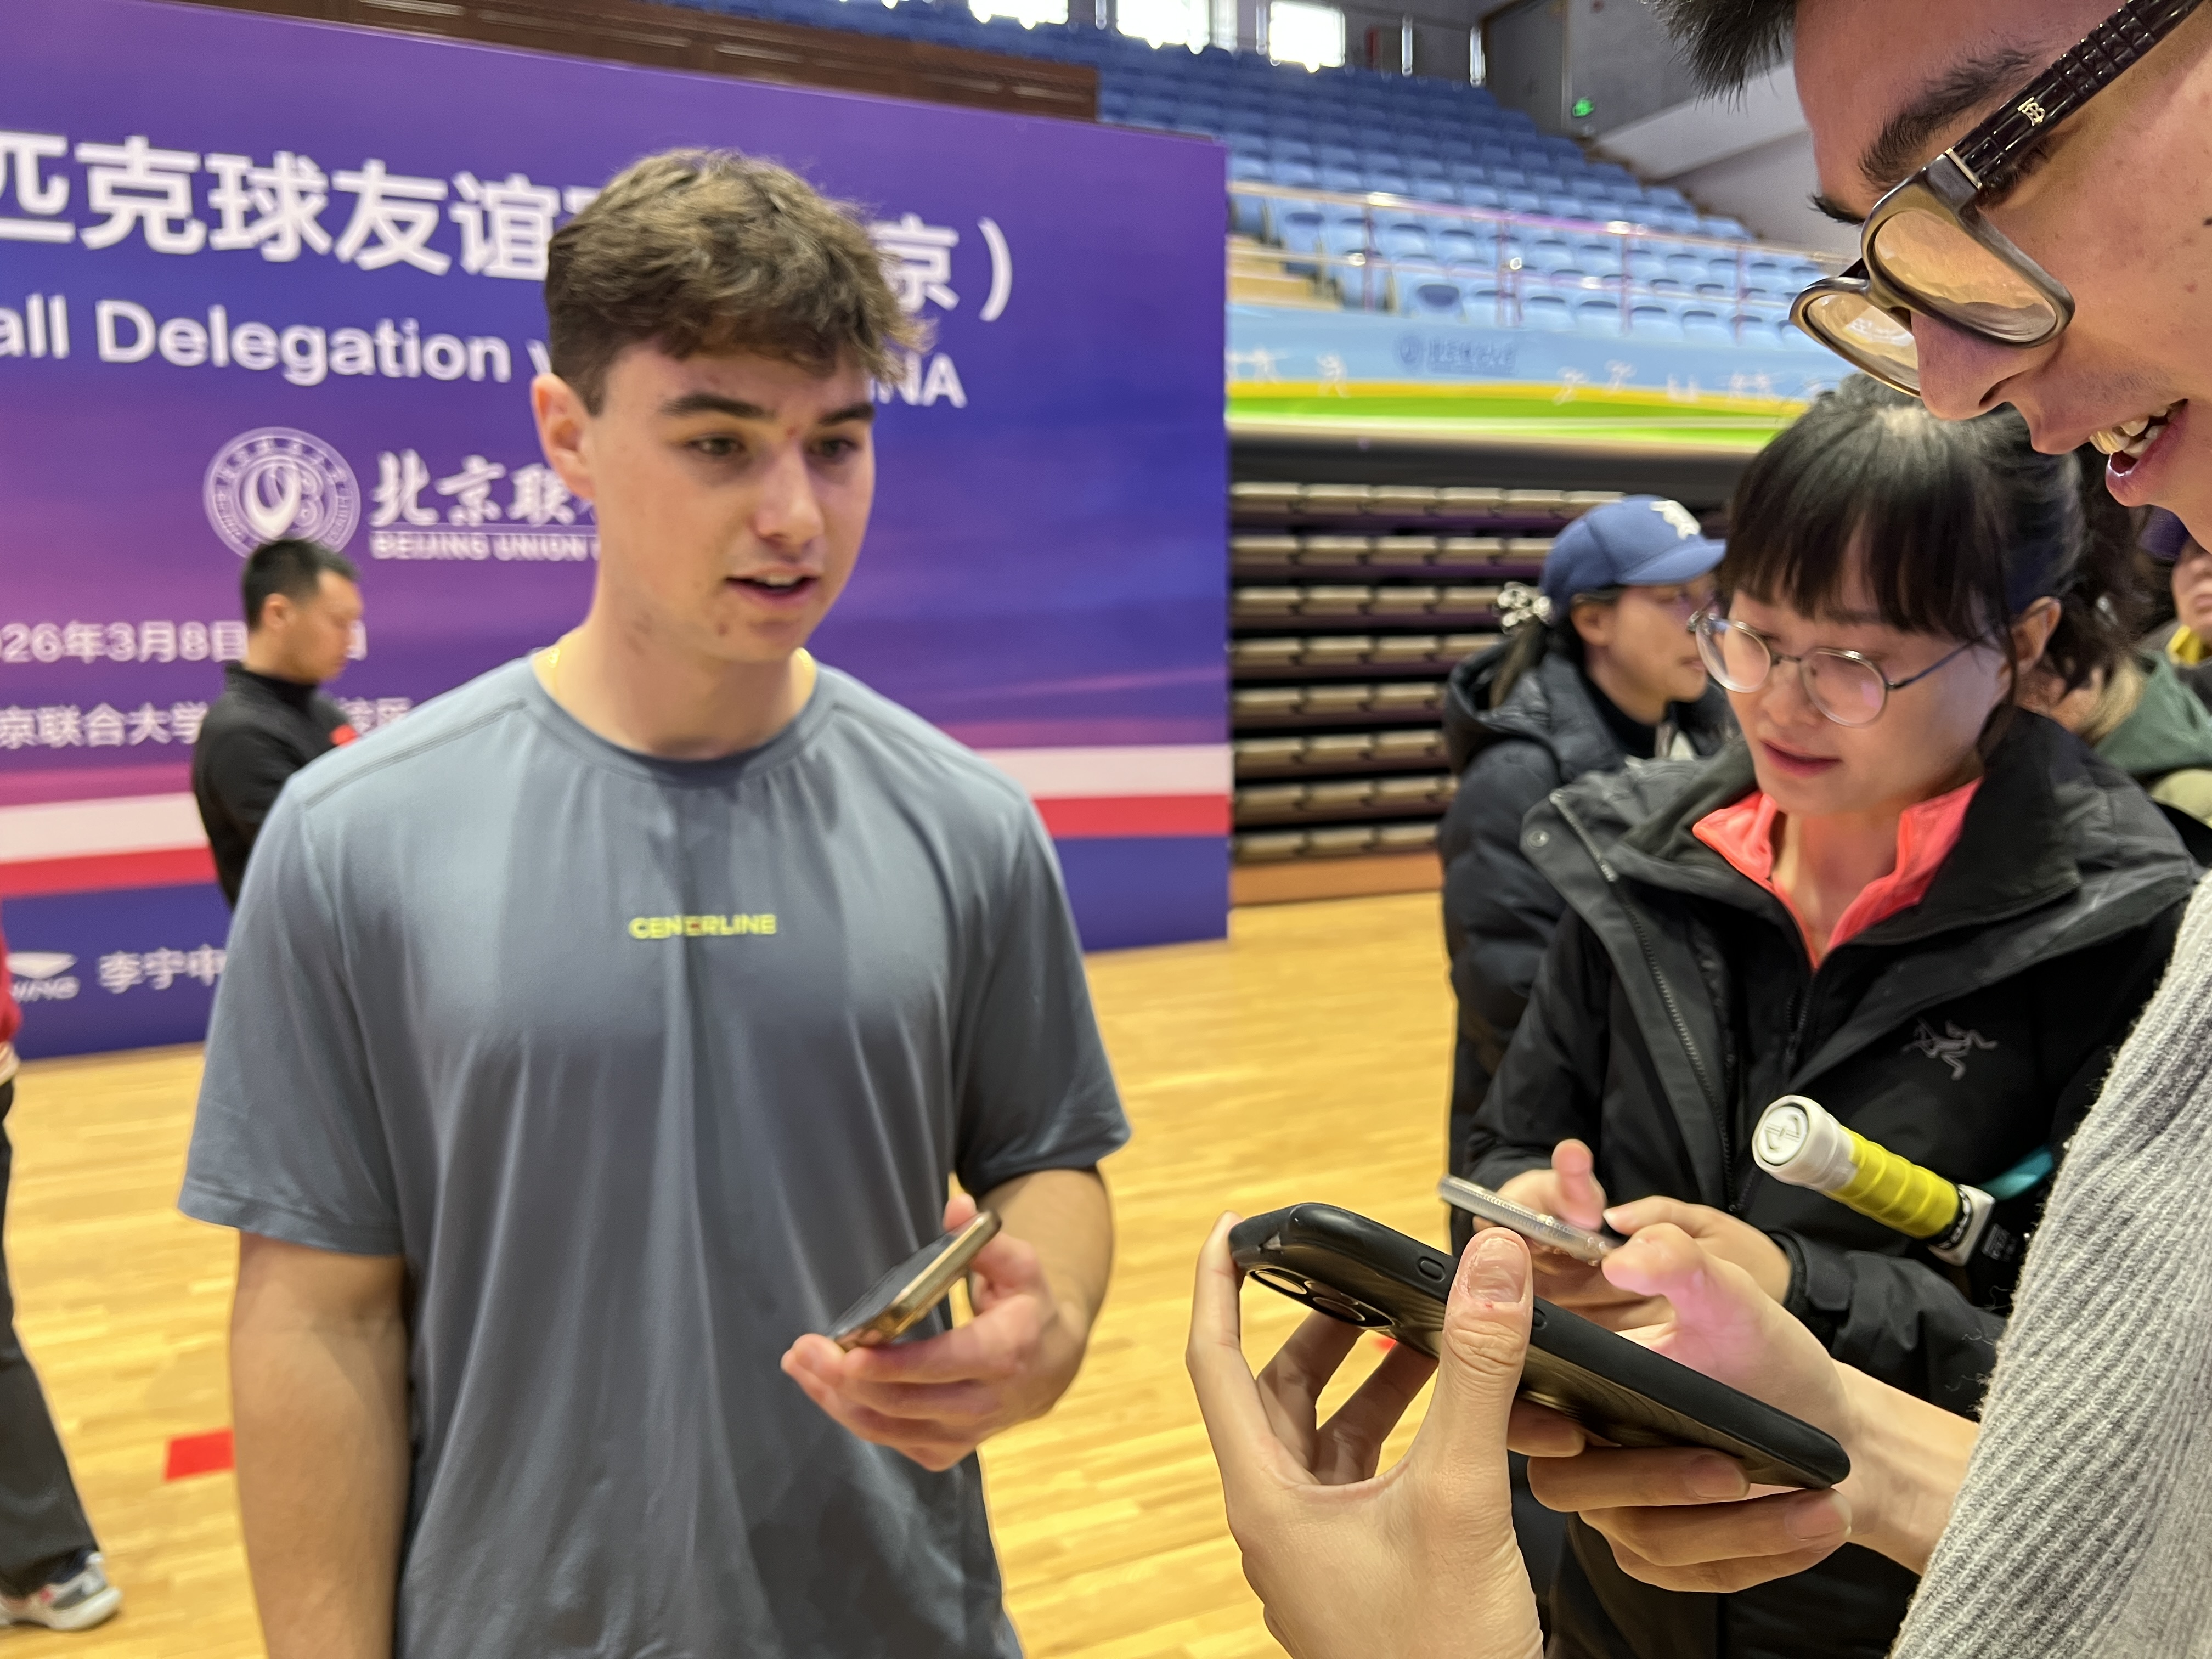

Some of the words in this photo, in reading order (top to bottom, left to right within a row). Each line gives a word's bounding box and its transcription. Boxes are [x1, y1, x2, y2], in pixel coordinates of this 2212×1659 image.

[0, 129, 602, 282] 匹克球友谊
[95, 300, 511, 386] Delegation
[870, 352, 968, 409] NA
[370, 448, 596, 527] 北京联
[369, 533, 492, 560] BEIJING
[493, 535, 588, 561] UNION
